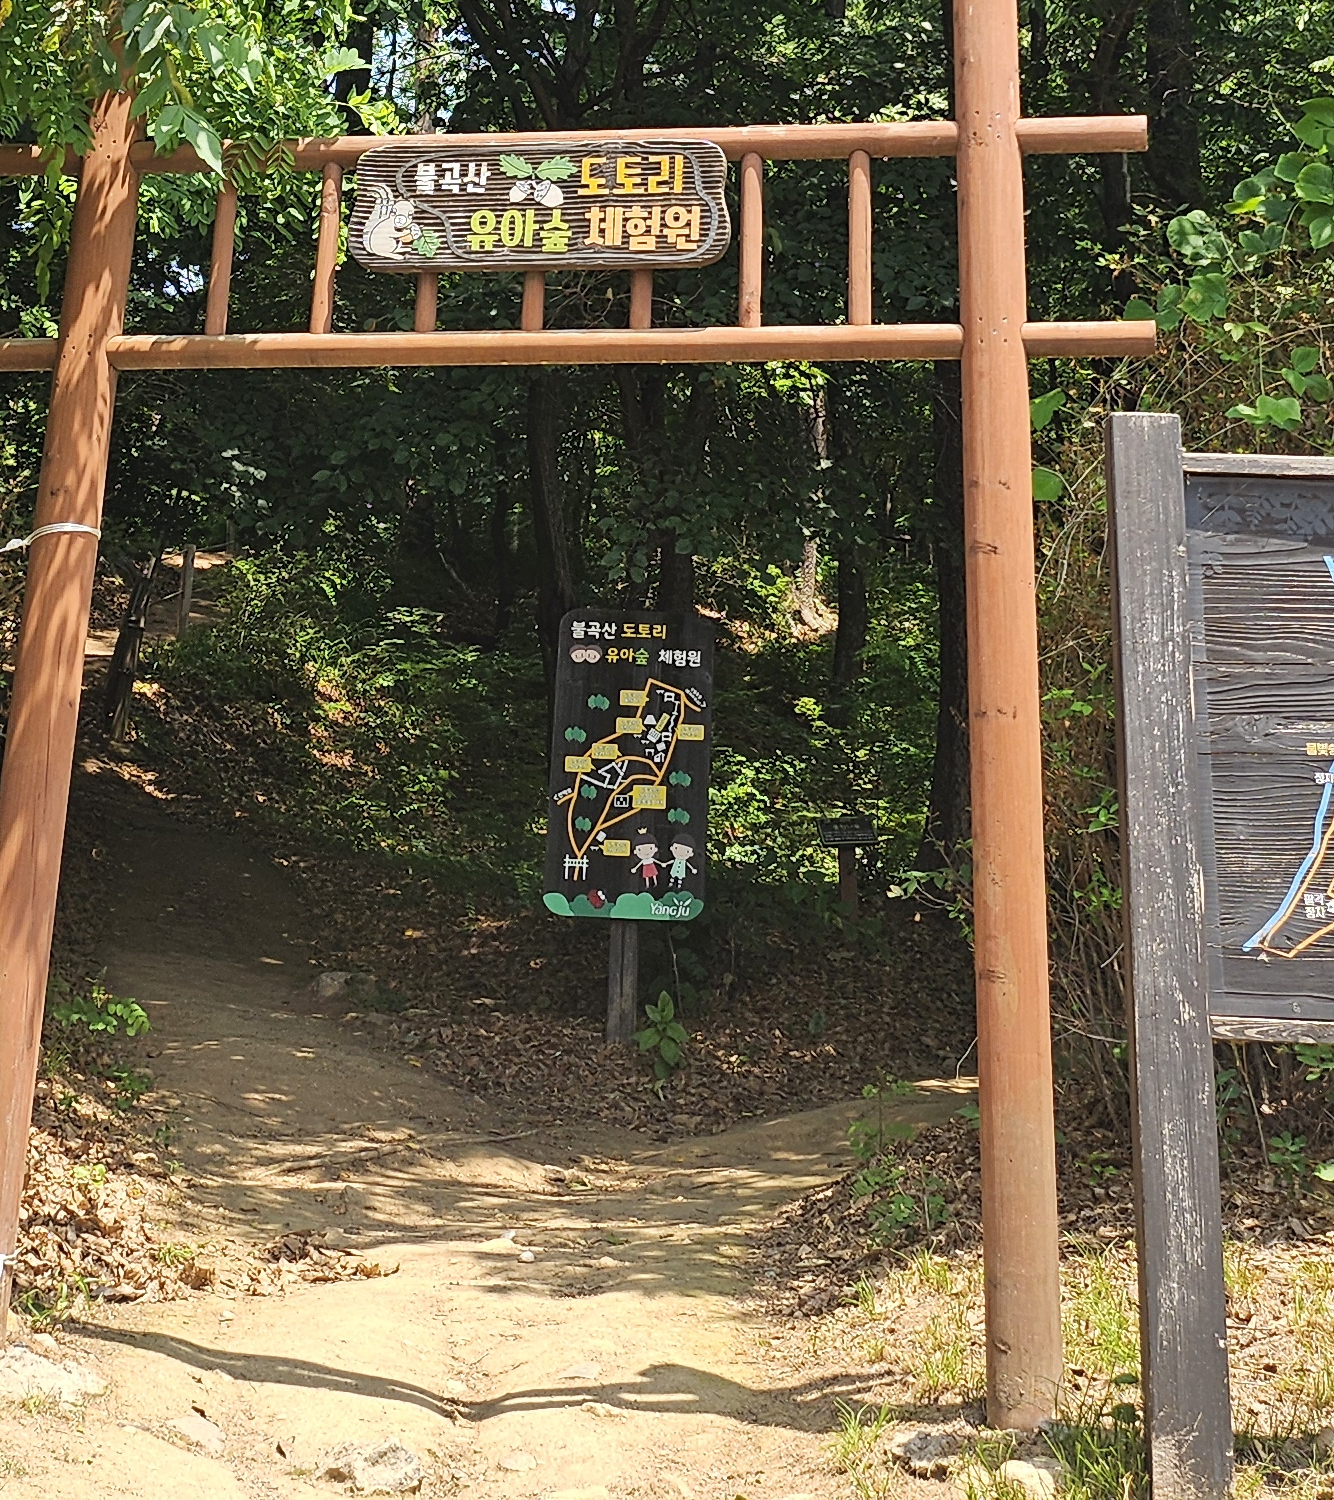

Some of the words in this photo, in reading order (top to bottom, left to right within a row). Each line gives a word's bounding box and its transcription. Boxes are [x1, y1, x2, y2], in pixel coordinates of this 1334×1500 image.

[413, 162, 492, 194] 불곡산
[577, 154, 684, 196] 도토리
[466, 209, 572, 252] 유아숲
[584, 205, 701, 252] 체험원
[570, 620, 617, 640] 불곡산
[620, 622, 667, 639] 도토리
[605, 647, 649, 666] 유아숲
[657, 649, 701, 667] 체험원
